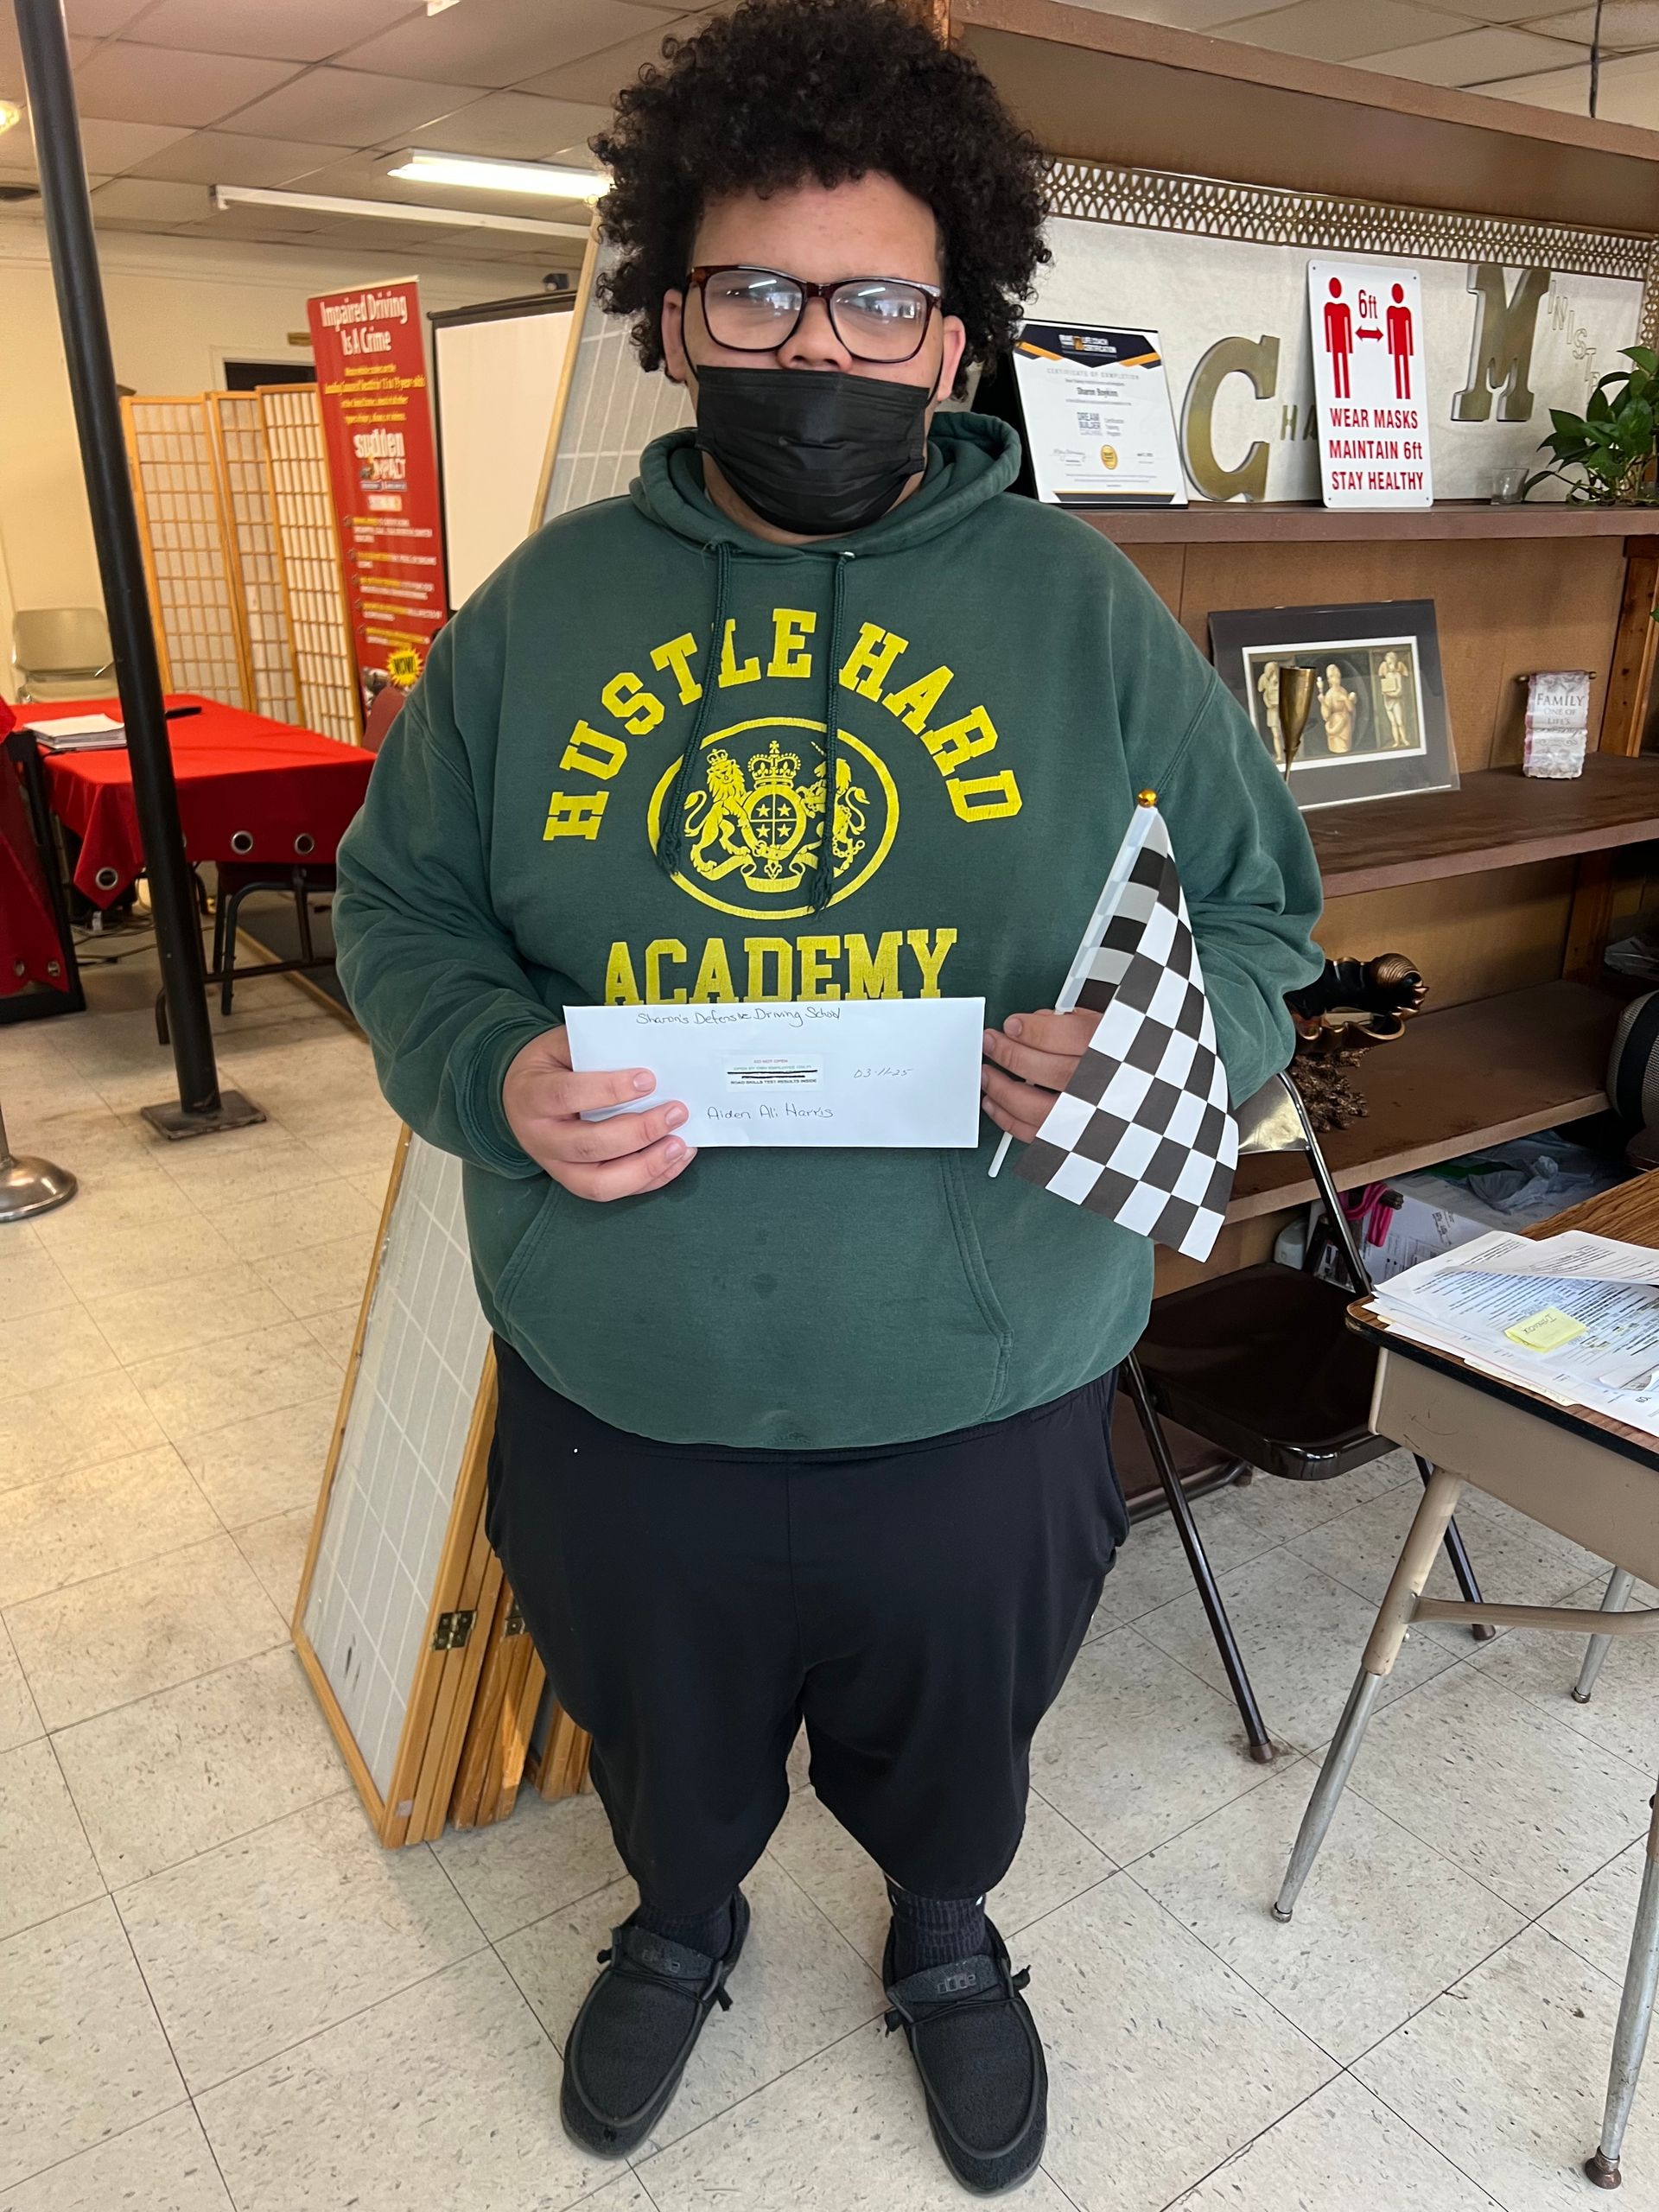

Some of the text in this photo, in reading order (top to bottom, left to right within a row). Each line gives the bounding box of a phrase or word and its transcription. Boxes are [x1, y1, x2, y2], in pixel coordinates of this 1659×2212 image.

[320, 290, 408, 332] Impaired Driving
[1358, 289, 1377, 319] 6ft
[340, 326, 391, 356] Is A Crime
[1330, 408, 1418, 429] WEAR MASKS
[353, 429, 405, 458] sudden
[1329, 440, 1422, 460] MAINTAIN 6ft
[1332, 472, 1423, 490] STAY HEALTHY
[1536, 693, 1585, 707] FAMILY
[543, 608, 1023, 841] HUSTLE HARD
[605, 927, 957, 1006] ACADEMY
[636, 1013, 690, 1025] Sharon's
[754, 1007, 803, 1027] Driving
[804, 1007, 841, 1020] School
[708, 1106, 751, 1121] Aiden
[785, 1102, 834, 1118] Harris
